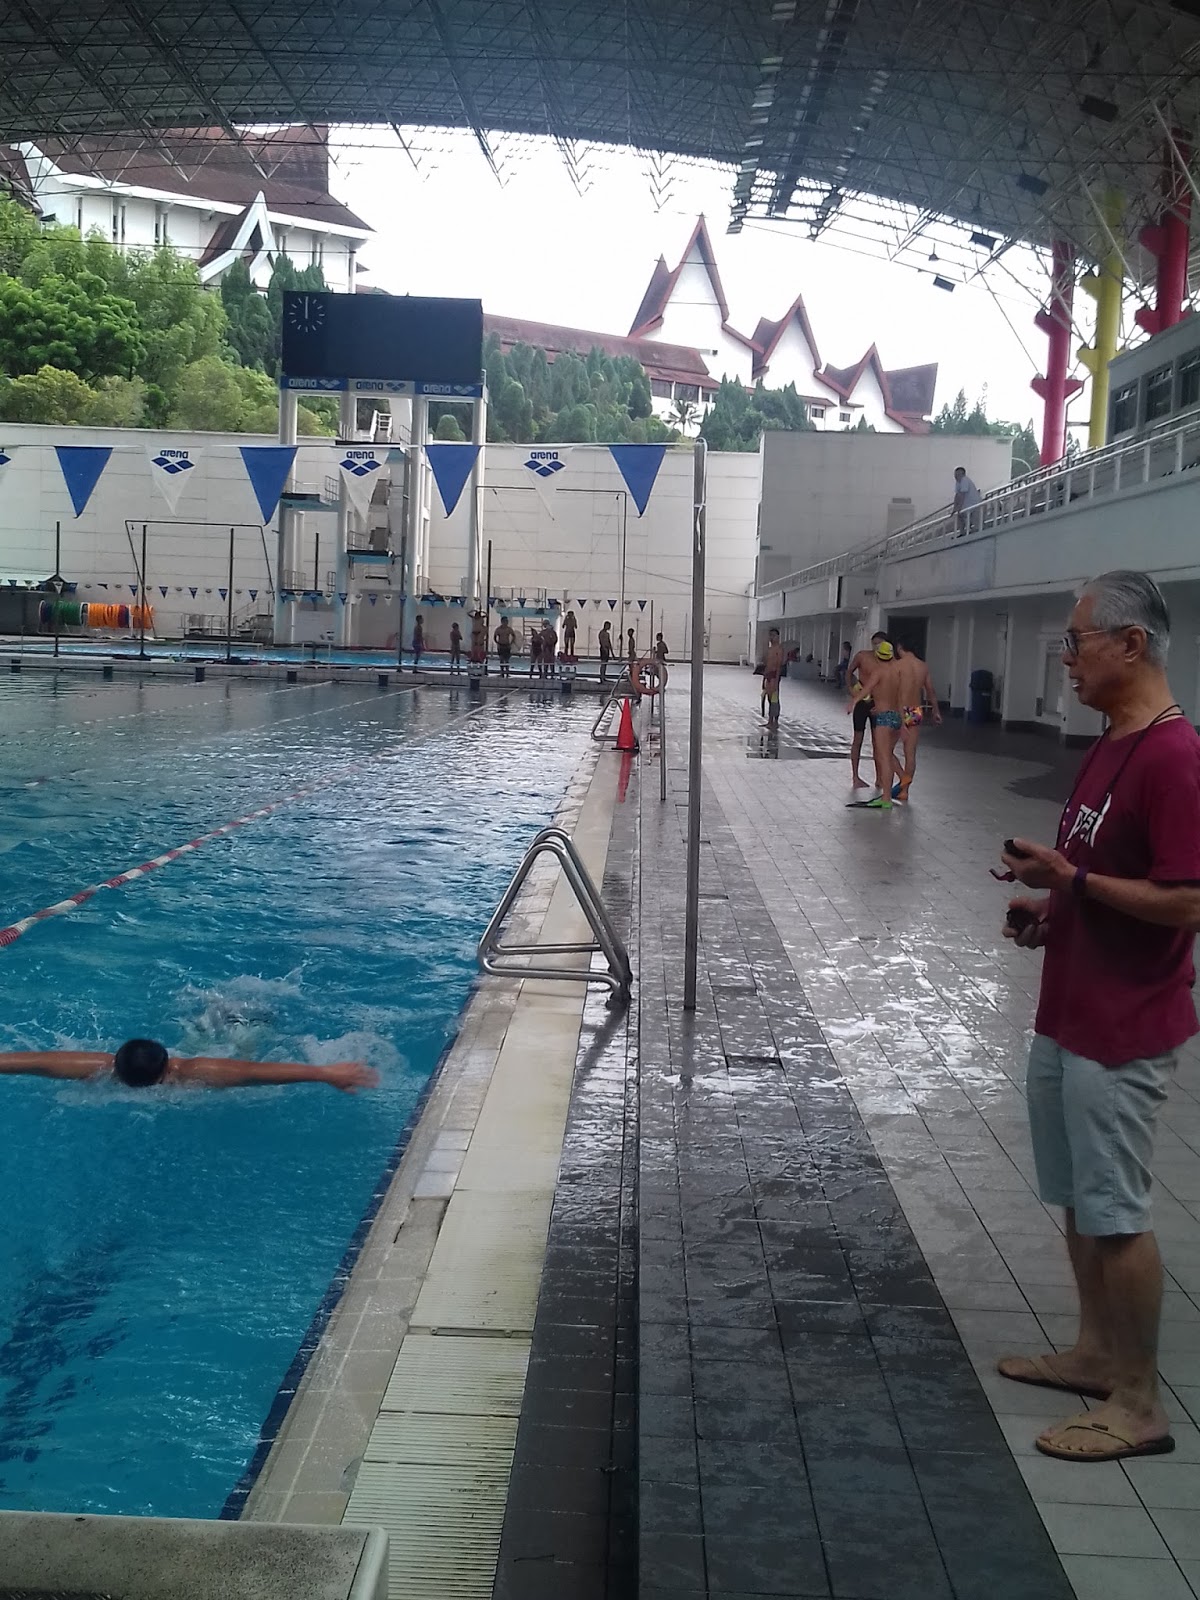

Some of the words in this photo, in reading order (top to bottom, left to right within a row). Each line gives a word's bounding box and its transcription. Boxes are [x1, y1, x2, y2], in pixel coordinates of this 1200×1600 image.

[288, 378, 317, 388] arena
[356, 381, 384, 390] arena
[423, 384, 451, 393] arena
[160, 449, 189, 459] arena
[346, 450, 375, 460] arena
[530, 451, 559, 460] arena
